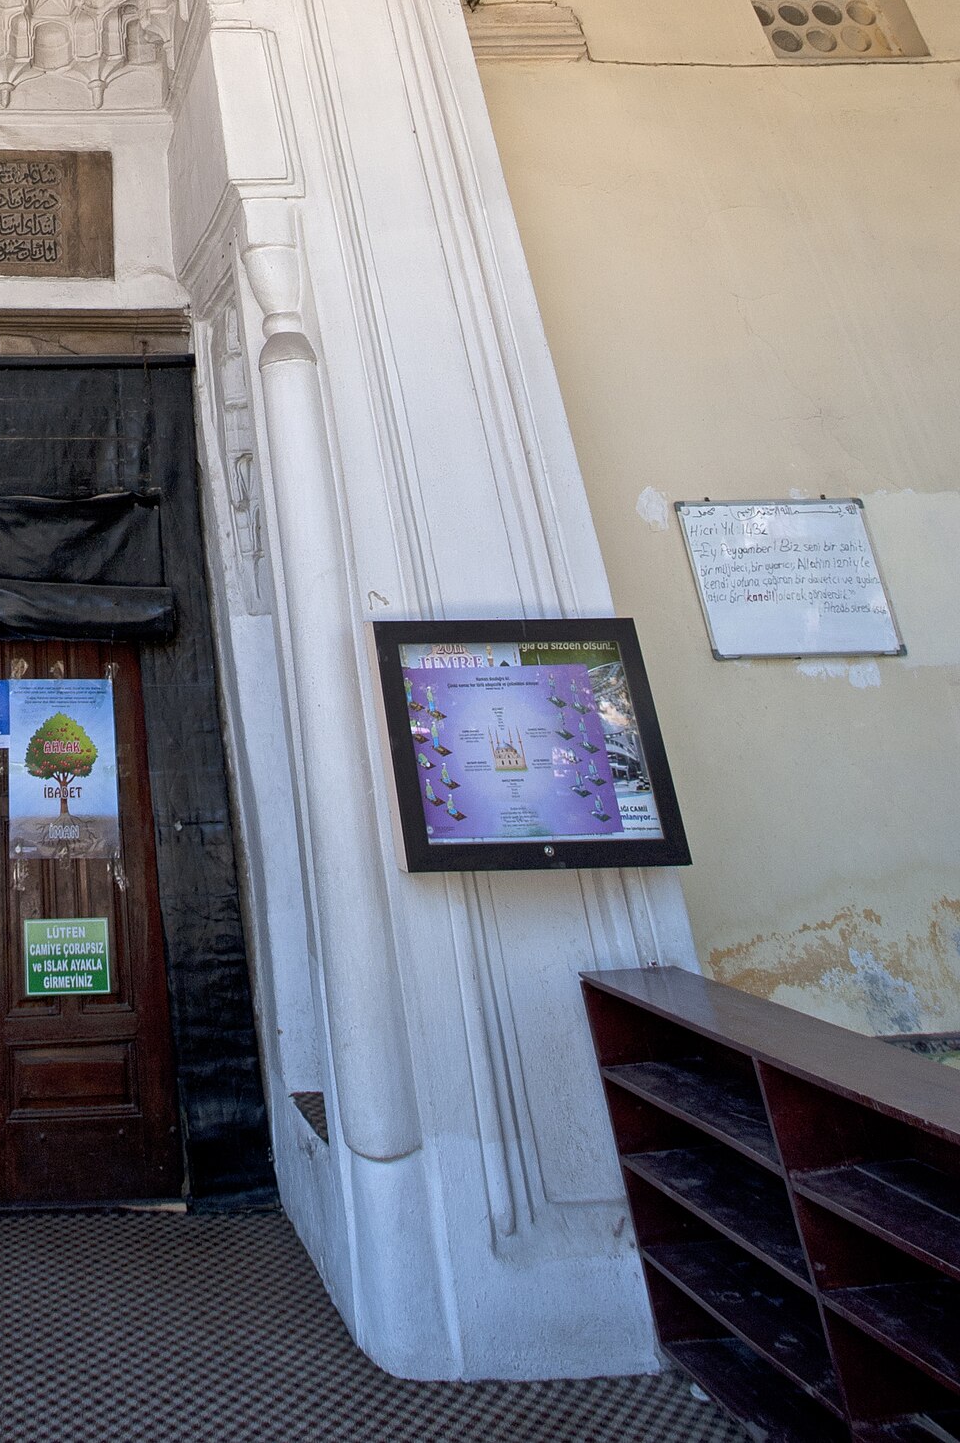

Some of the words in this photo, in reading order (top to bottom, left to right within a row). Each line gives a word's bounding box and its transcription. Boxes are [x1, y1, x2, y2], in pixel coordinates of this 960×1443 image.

[690, 523, 718, 537] Hicri
[742, 521, 768, 537] 1432
[779, 538, 801, 553] Biz
[803, 542, 820, 553] seni
[823, 540, 837, 553] bir
[700, 565, 714, 577] bir
[751, 561, 764, 574] bir
[703, 577, 729, 590] kendi
[731, 576, 760, 589] yoluna
[843, 576, 853, 584] ve
[550, 642, 581, 650] sizden
[43, 740, 81, 754] AHLAK
[43, 784, 83, 799] İBADET
[48, 822, 80, 839] İMAN
[46, 924, 86, 939] LÜTFEN
[29, 941, 61, 956] CAMİYE
[63, 942, 105, 958] ÇORAPSIZ
[32, 963, 42, 972] ve
[43, 959, 69, 972] ISLAK
[70, 958, 103, 972] AYAKLA
[43, 972, 93, 989] GİRMEYİNİZ
